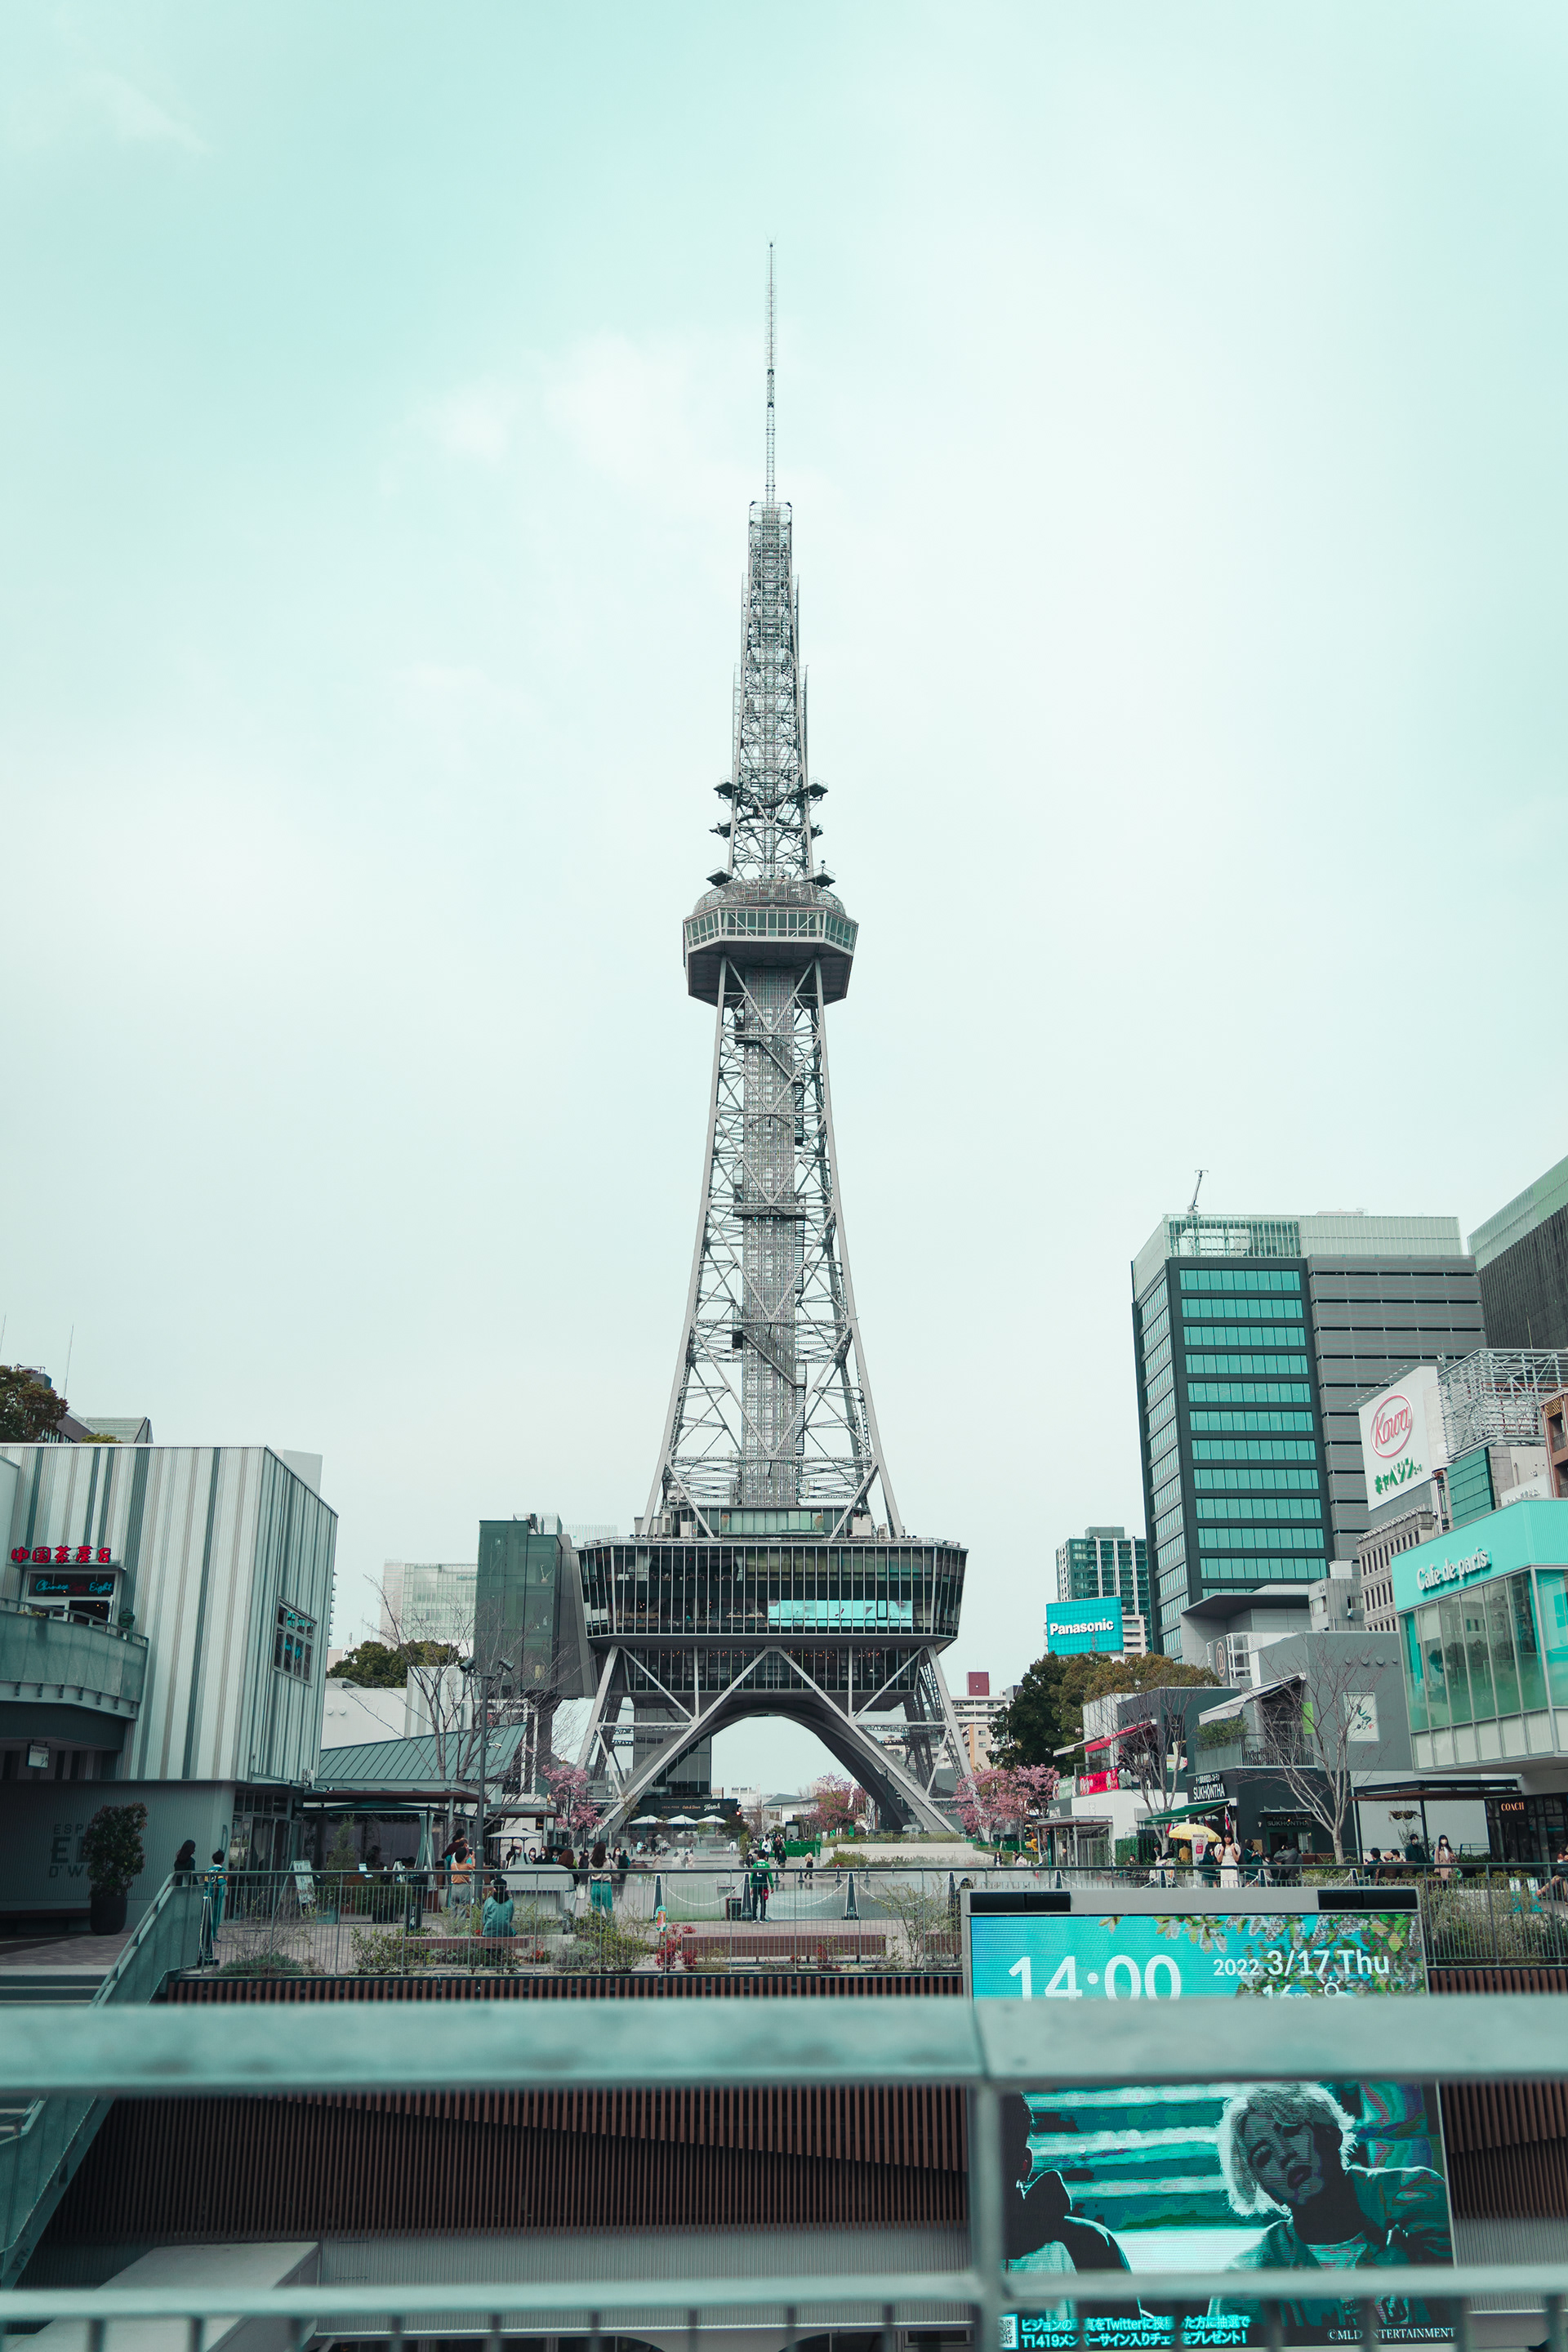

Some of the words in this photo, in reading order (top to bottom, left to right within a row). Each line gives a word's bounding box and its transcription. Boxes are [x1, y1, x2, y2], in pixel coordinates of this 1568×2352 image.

[1375, 1406, 1410, 1448] Kowa
[1374, 1457, 1414, 1494] キャベジン
[11, 1545, 111, 1563] 中国茶房8
[1443, 1557, 1456, 1581] de
[1458, 1547, 1489, 1580] paris
[35, 1579, 69, 1592] Chinese
[89, 1582, 113, 1594] Eight
[1050, 1618, 1114, 1636] Panasonic
[1192, 1783, 1225, 1800] SUKHONTHA
[1501, 1802, 1525, 1811] COACH
[1213, 1958, 1260, 1976] 2022
[1267, 1949, 1330, 1976] 3/17
[1336, 1949, 1390, 1975] Thu
[1369, 2327, 1456, 2340] NTERTAINMENT
